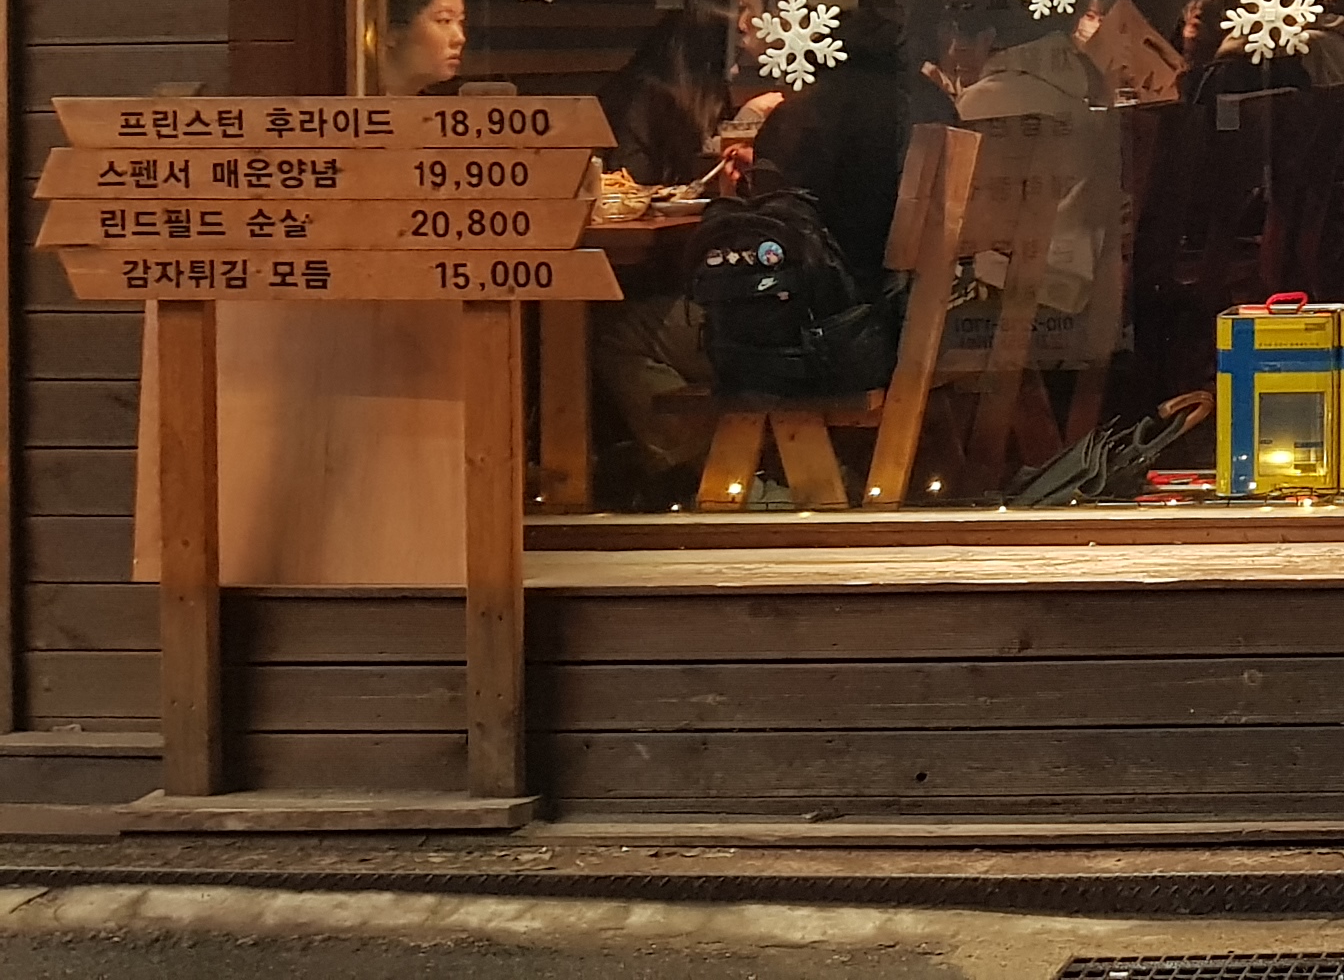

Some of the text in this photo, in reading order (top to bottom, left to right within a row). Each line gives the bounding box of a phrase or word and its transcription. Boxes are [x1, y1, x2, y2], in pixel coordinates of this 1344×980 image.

[118, 107, 551, 140] 프린스턴 후라이드 18,900
[97, 158, 529, 192] 스펜서 매운양념 19,900
[100, 209, 531, 241] 린드필드 순살 20,800
[122, 260, 554, 293] 감자튀김 모듬 15,000
